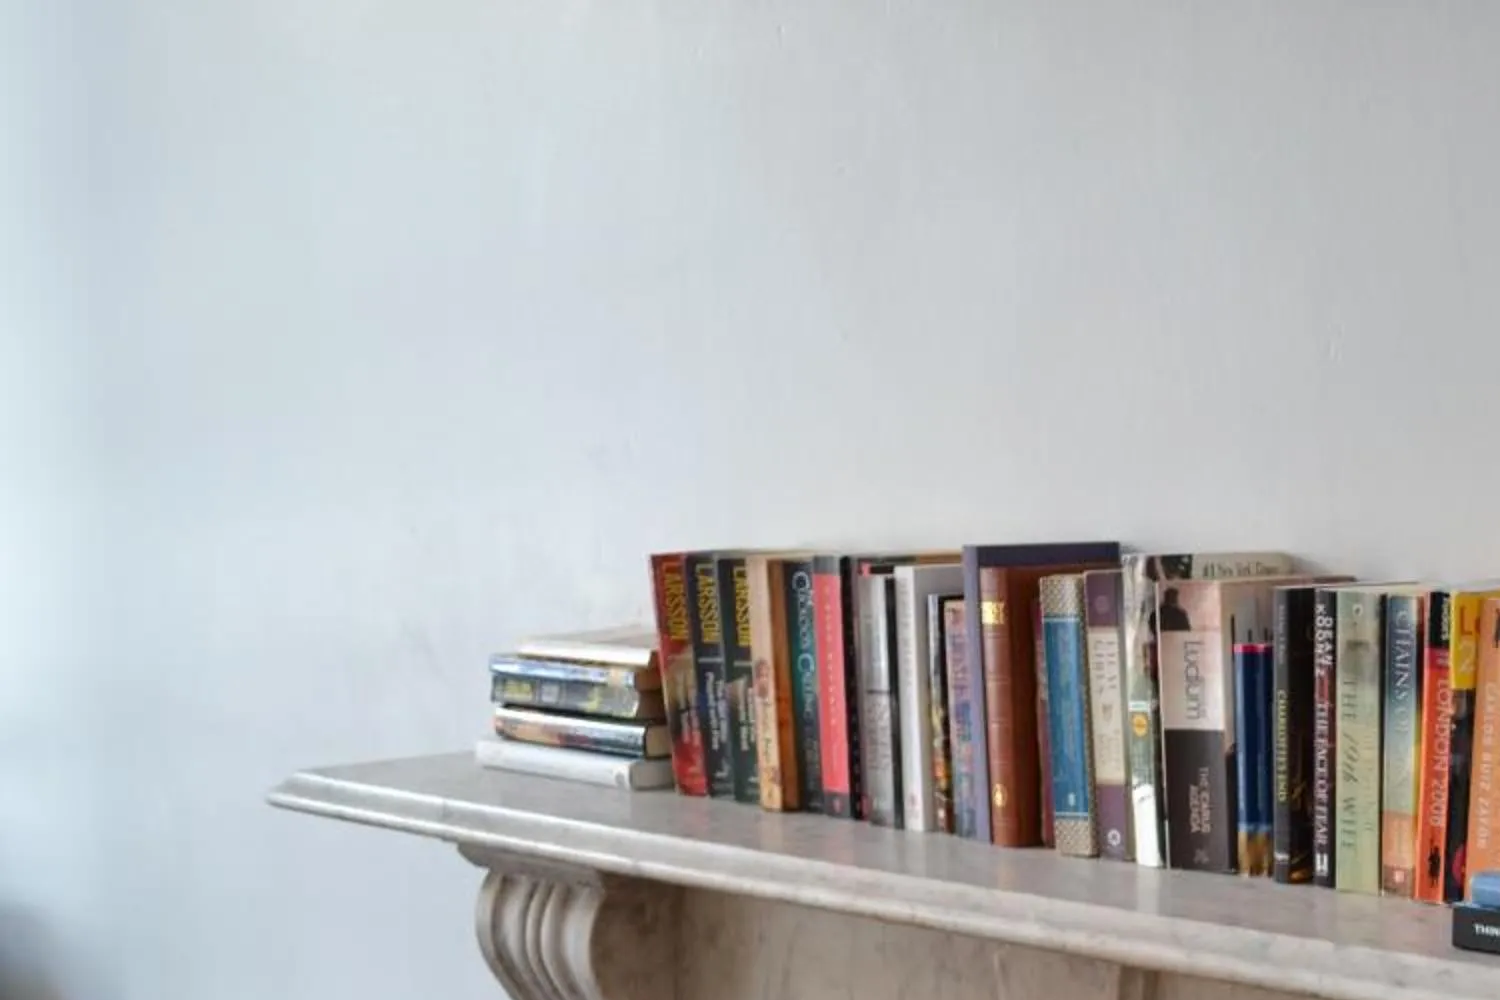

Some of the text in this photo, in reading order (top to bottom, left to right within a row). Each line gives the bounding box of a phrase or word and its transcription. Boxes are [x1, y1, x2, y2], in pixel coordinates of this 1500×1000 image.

[662, 562, 688, 640] LARSSON
[696, 563, 720, 643] LARSSON
[733, 567, 751, 646] LARSSON
[1184, 641, 1206, 720] Ludlum
[1395, 610, 1414, 702] CHAINS
[1433, 678, 1453, 770] LONDON
